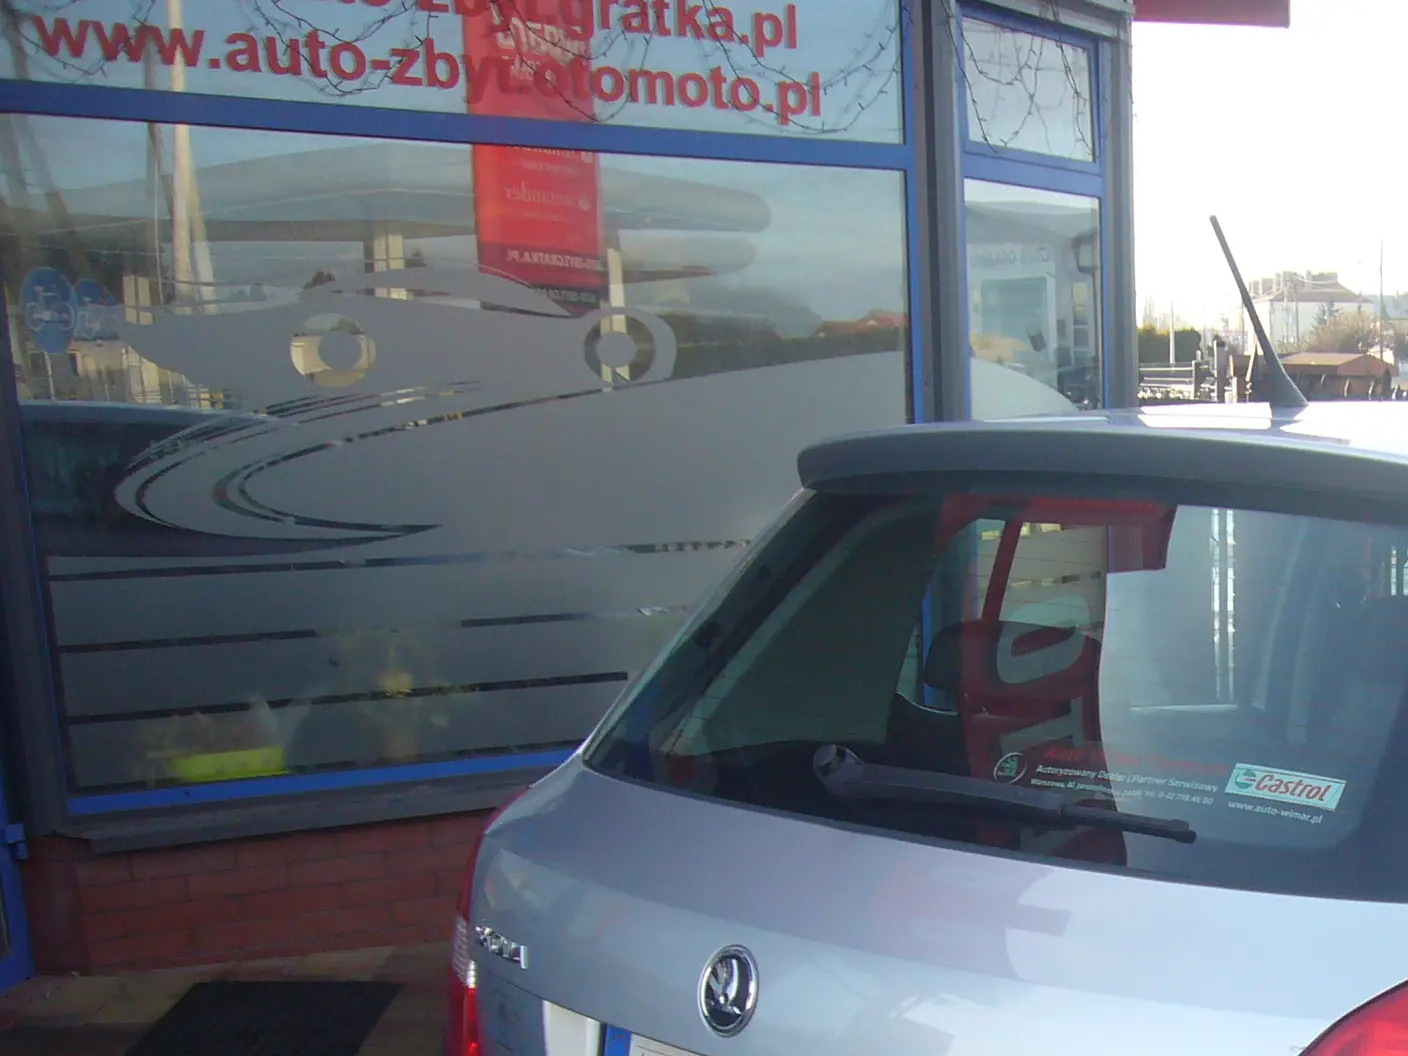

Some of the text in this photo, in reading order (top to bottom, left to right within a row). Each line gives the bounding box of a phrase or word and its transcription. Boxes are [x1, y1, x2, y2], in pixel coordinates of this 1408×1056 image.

[33, 14, 822, 125] www.auto-zbyt.otomoto.pl
[1168, 777, 1218, 793] Serwisowy
[1255, 774, 1332, 802] Castrol
[1228, 801, 1323, 824] www.auto-wimar.pl
